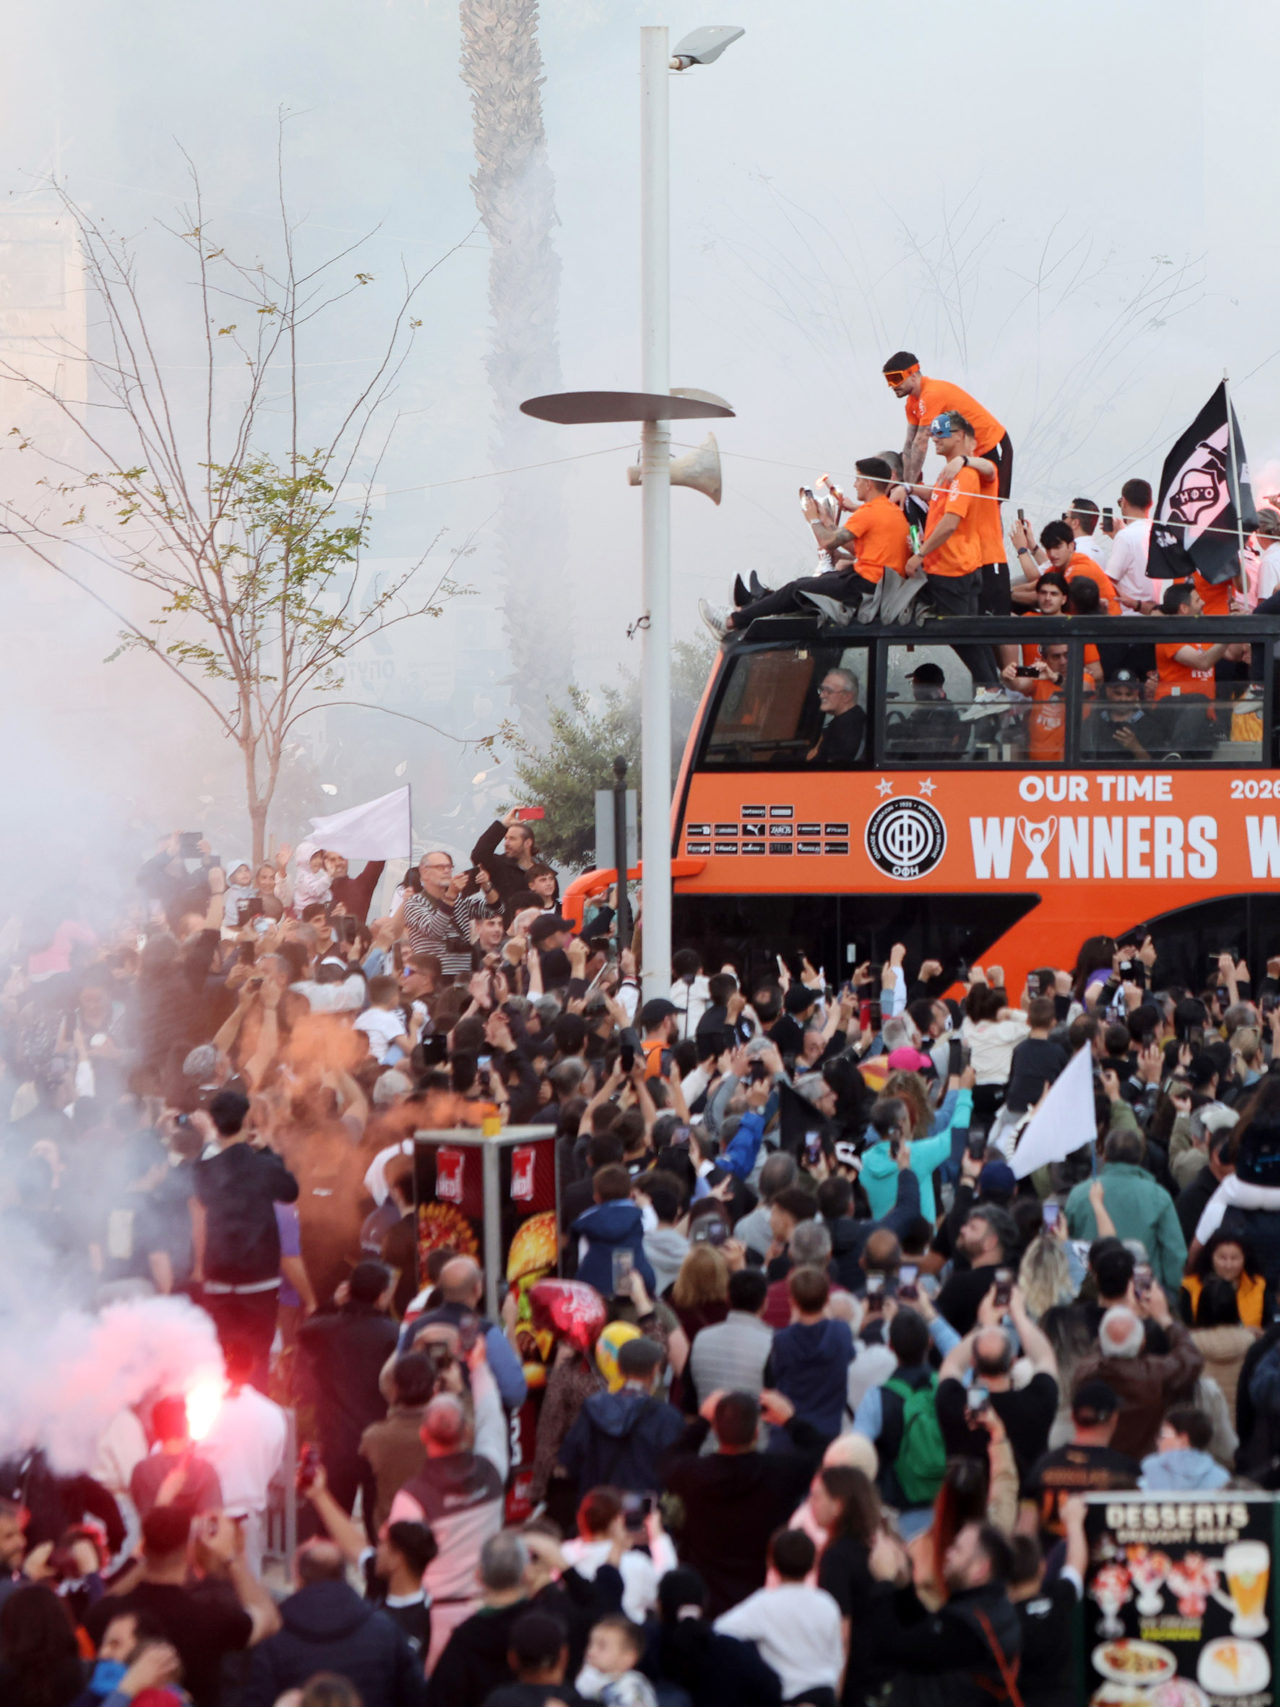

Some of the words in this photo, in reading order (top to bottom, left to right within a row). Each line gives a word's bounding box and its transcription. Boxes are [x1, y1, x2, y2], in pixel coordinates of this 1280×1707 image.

[1018, 776, 1089, 802] OUR
[1096, 776, 1173, 802] TIME
[892, 865, 919, 877] ΟΦΗ
[1106, 1502, 1249, 1530] DESSERTS
[1195, 1529, 1239, 1545] BEER
